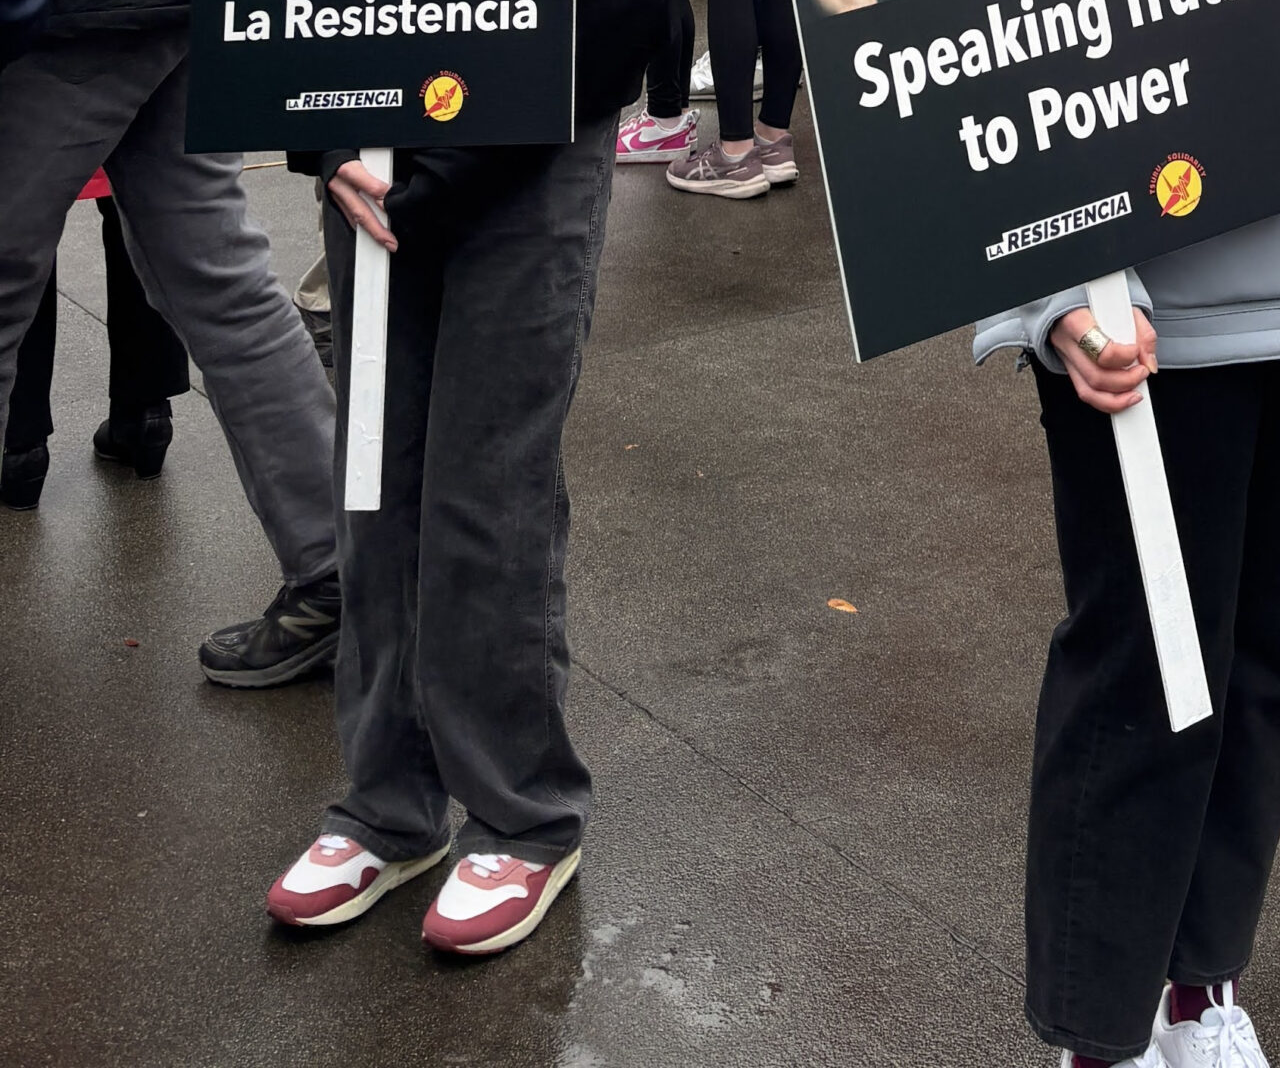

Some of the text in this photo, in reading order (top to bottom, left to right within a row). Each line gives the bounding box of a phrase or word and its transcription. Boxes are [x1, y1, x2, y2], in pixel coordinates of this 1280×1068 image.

[223, 0, 271, 42] La
[288, 91, 400, 109] LA RESISTENCIA
[958, 57, 1190, 173] to Power
[1149, 152, 1207, 195] TSURU SOLIDARITY
[988, 195, 1128, 258] LA RESISTENCIA
